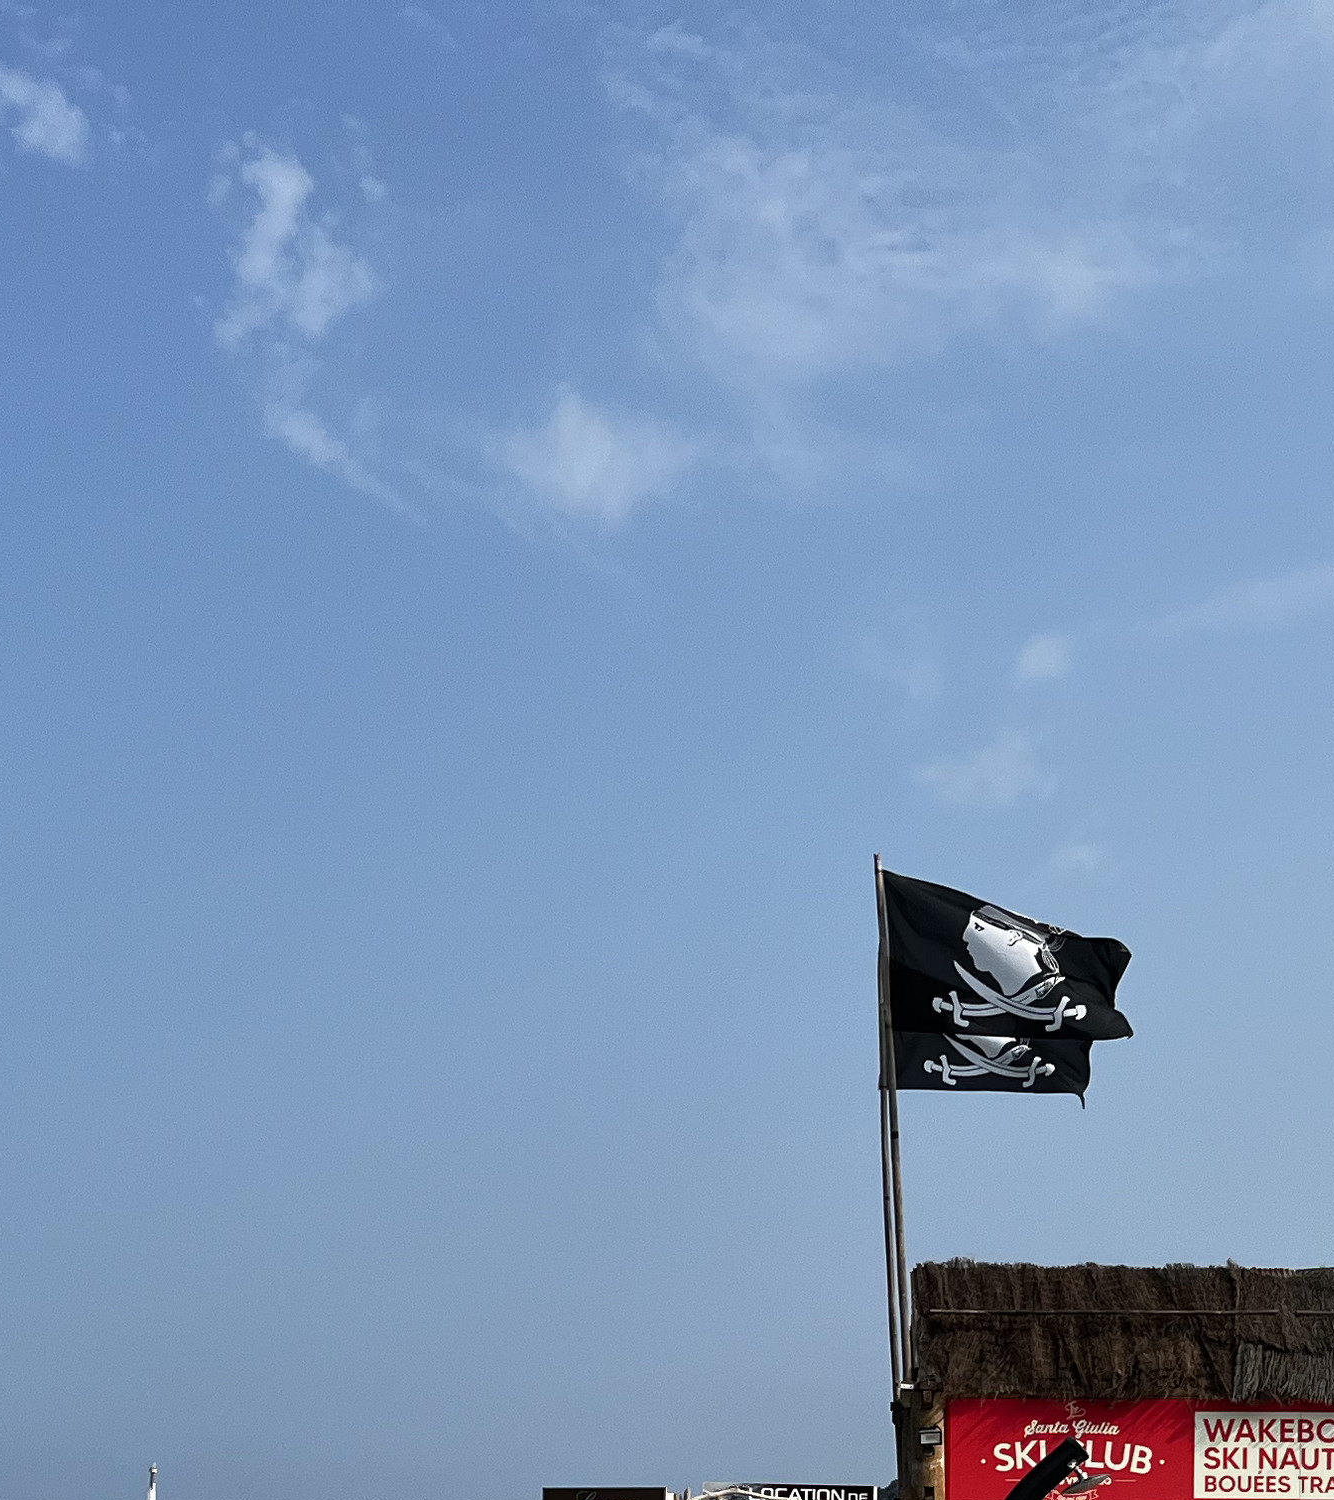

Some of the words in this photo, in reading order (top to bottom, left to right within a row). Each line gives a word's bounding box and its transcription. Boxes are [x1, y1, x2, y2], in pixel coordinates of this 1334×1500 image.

[1024, 1420, 1069, 1438] Santa
[1072, 1420, 1120, 1438] Giulia
[993, 1440, 1048, 1472] SKI
[1076, 1440, 1153, 1474] LUB
[1203, 1447, 1248, 1470] SKI
[1204, 1470, 1291, 1493] BOUÉES
